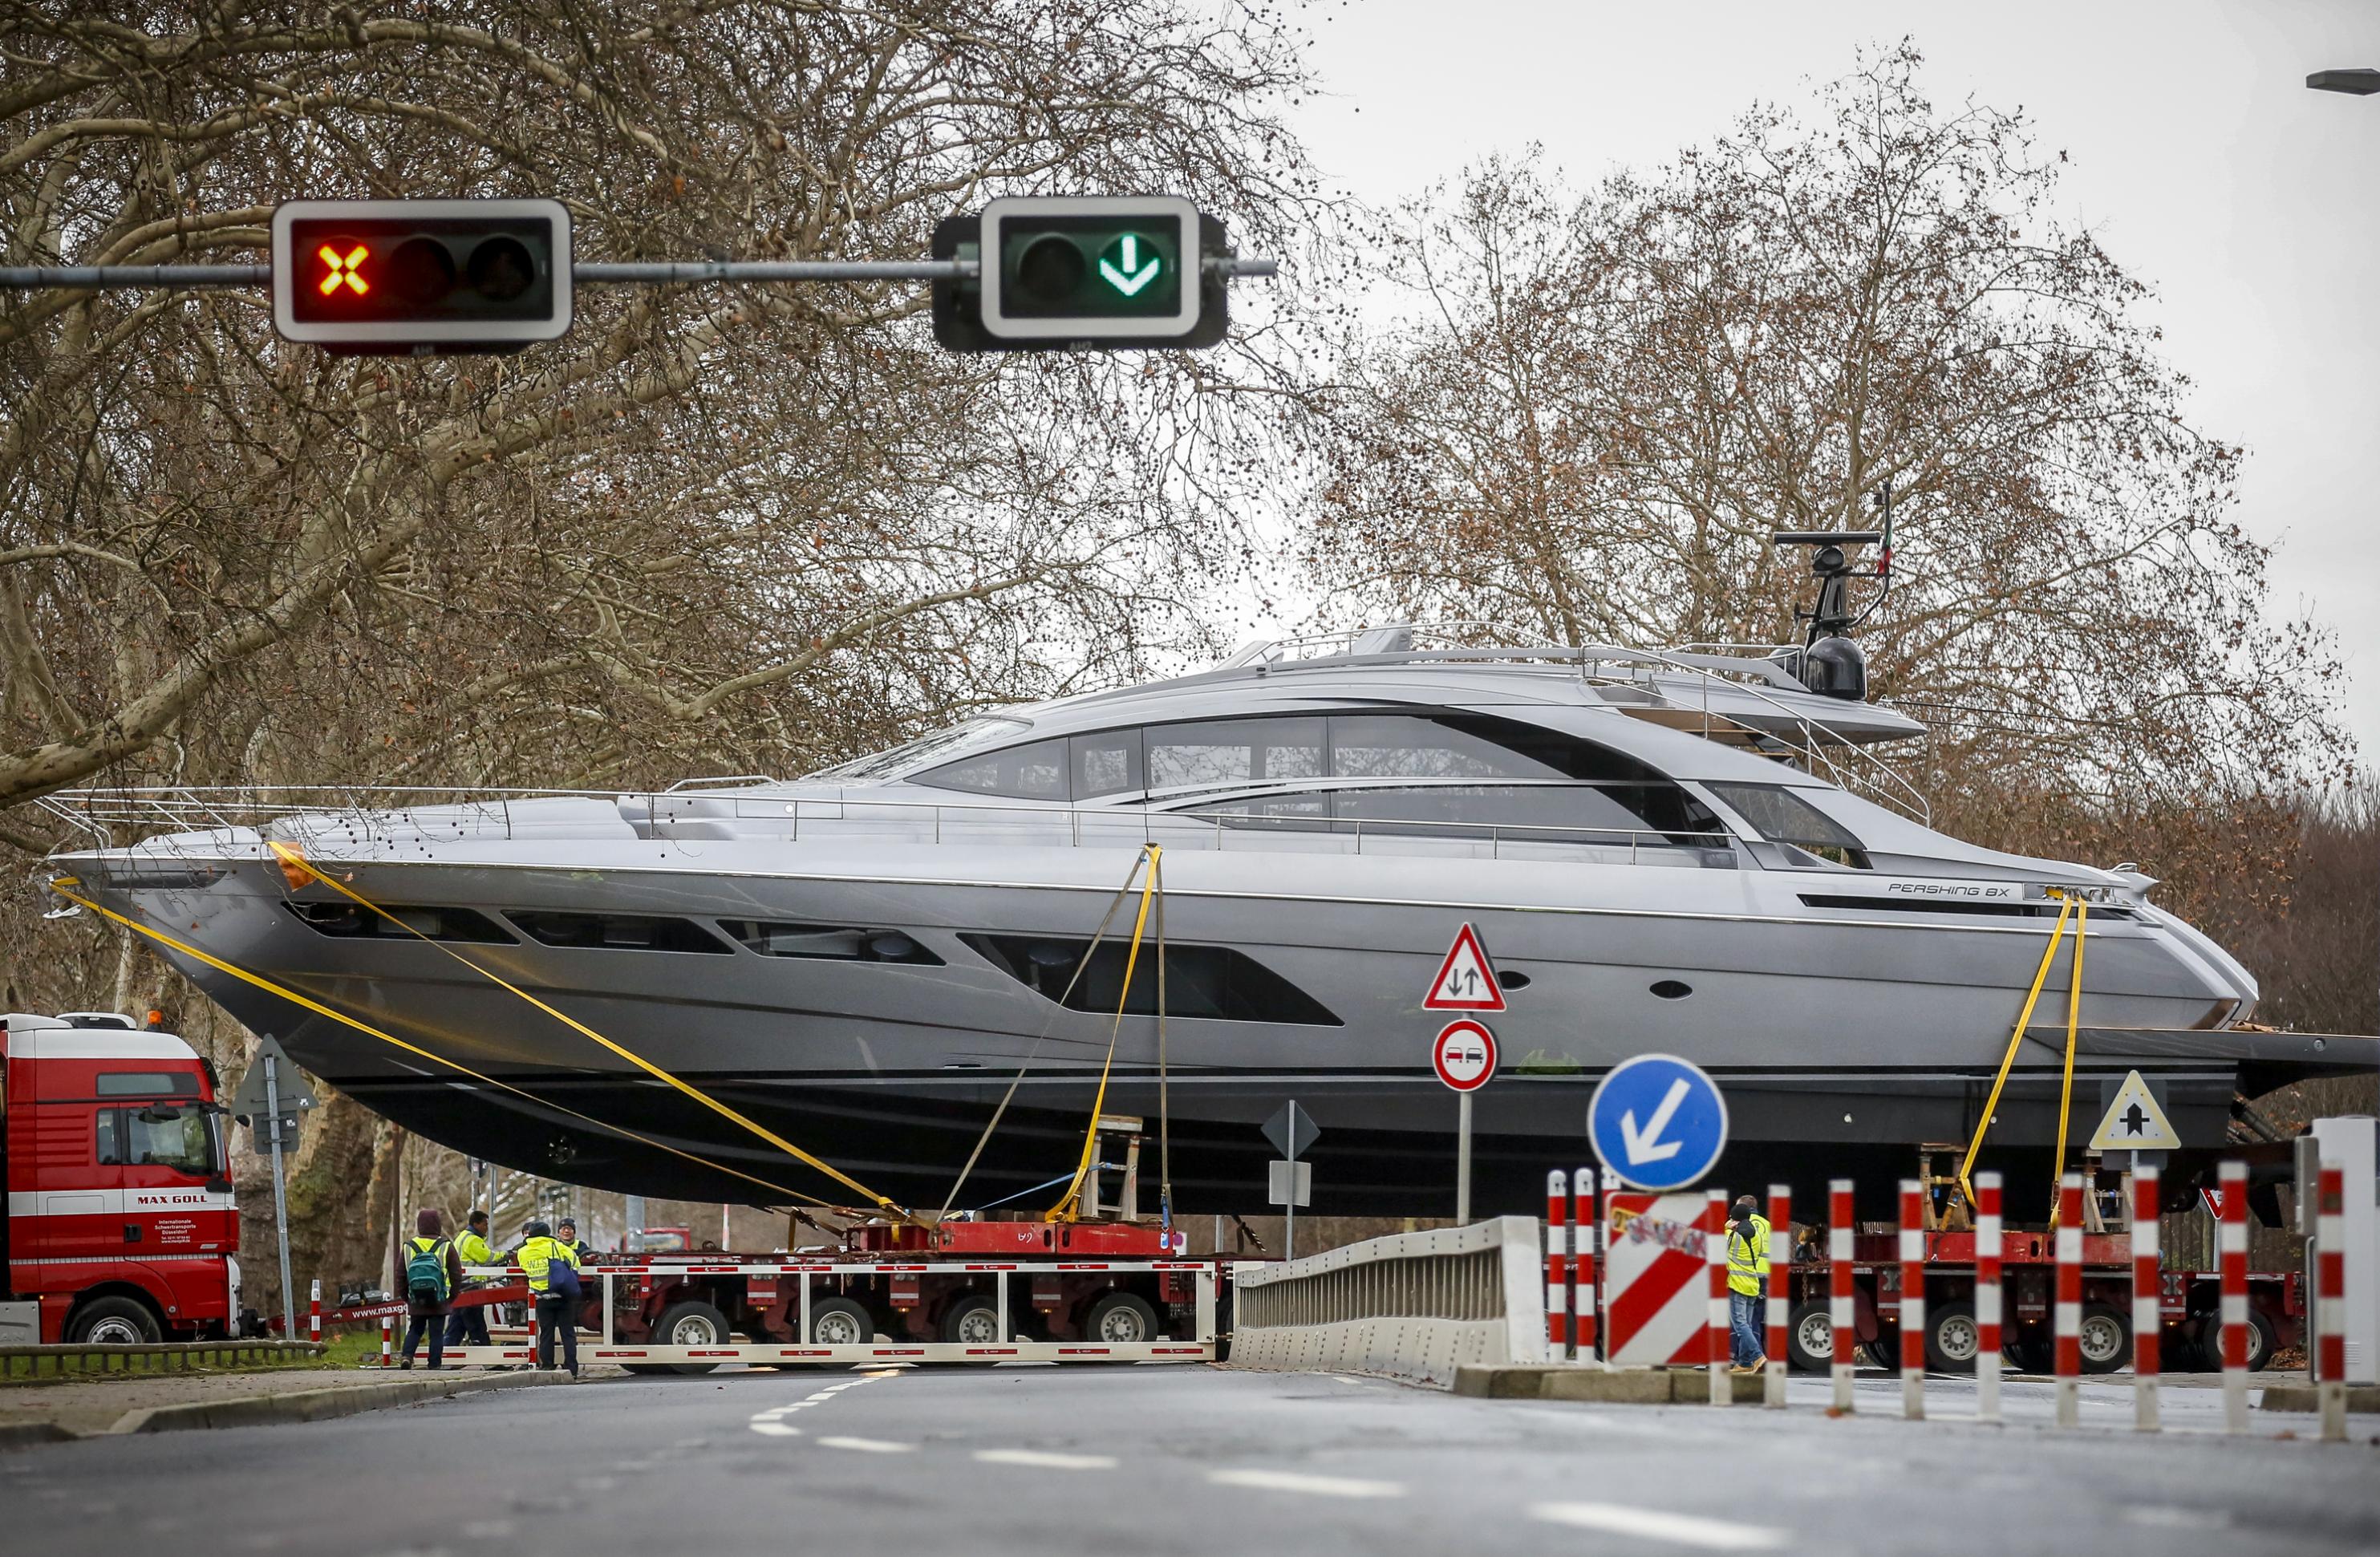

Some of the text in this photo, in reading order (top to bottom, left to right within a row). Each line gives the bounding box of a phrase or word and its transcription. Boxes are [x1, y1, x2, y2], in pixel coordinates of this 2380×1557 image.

[1888, 883, 2010, 898] PERSHING 8X
[138, 1195, 207, 1204] MAX GOLL
